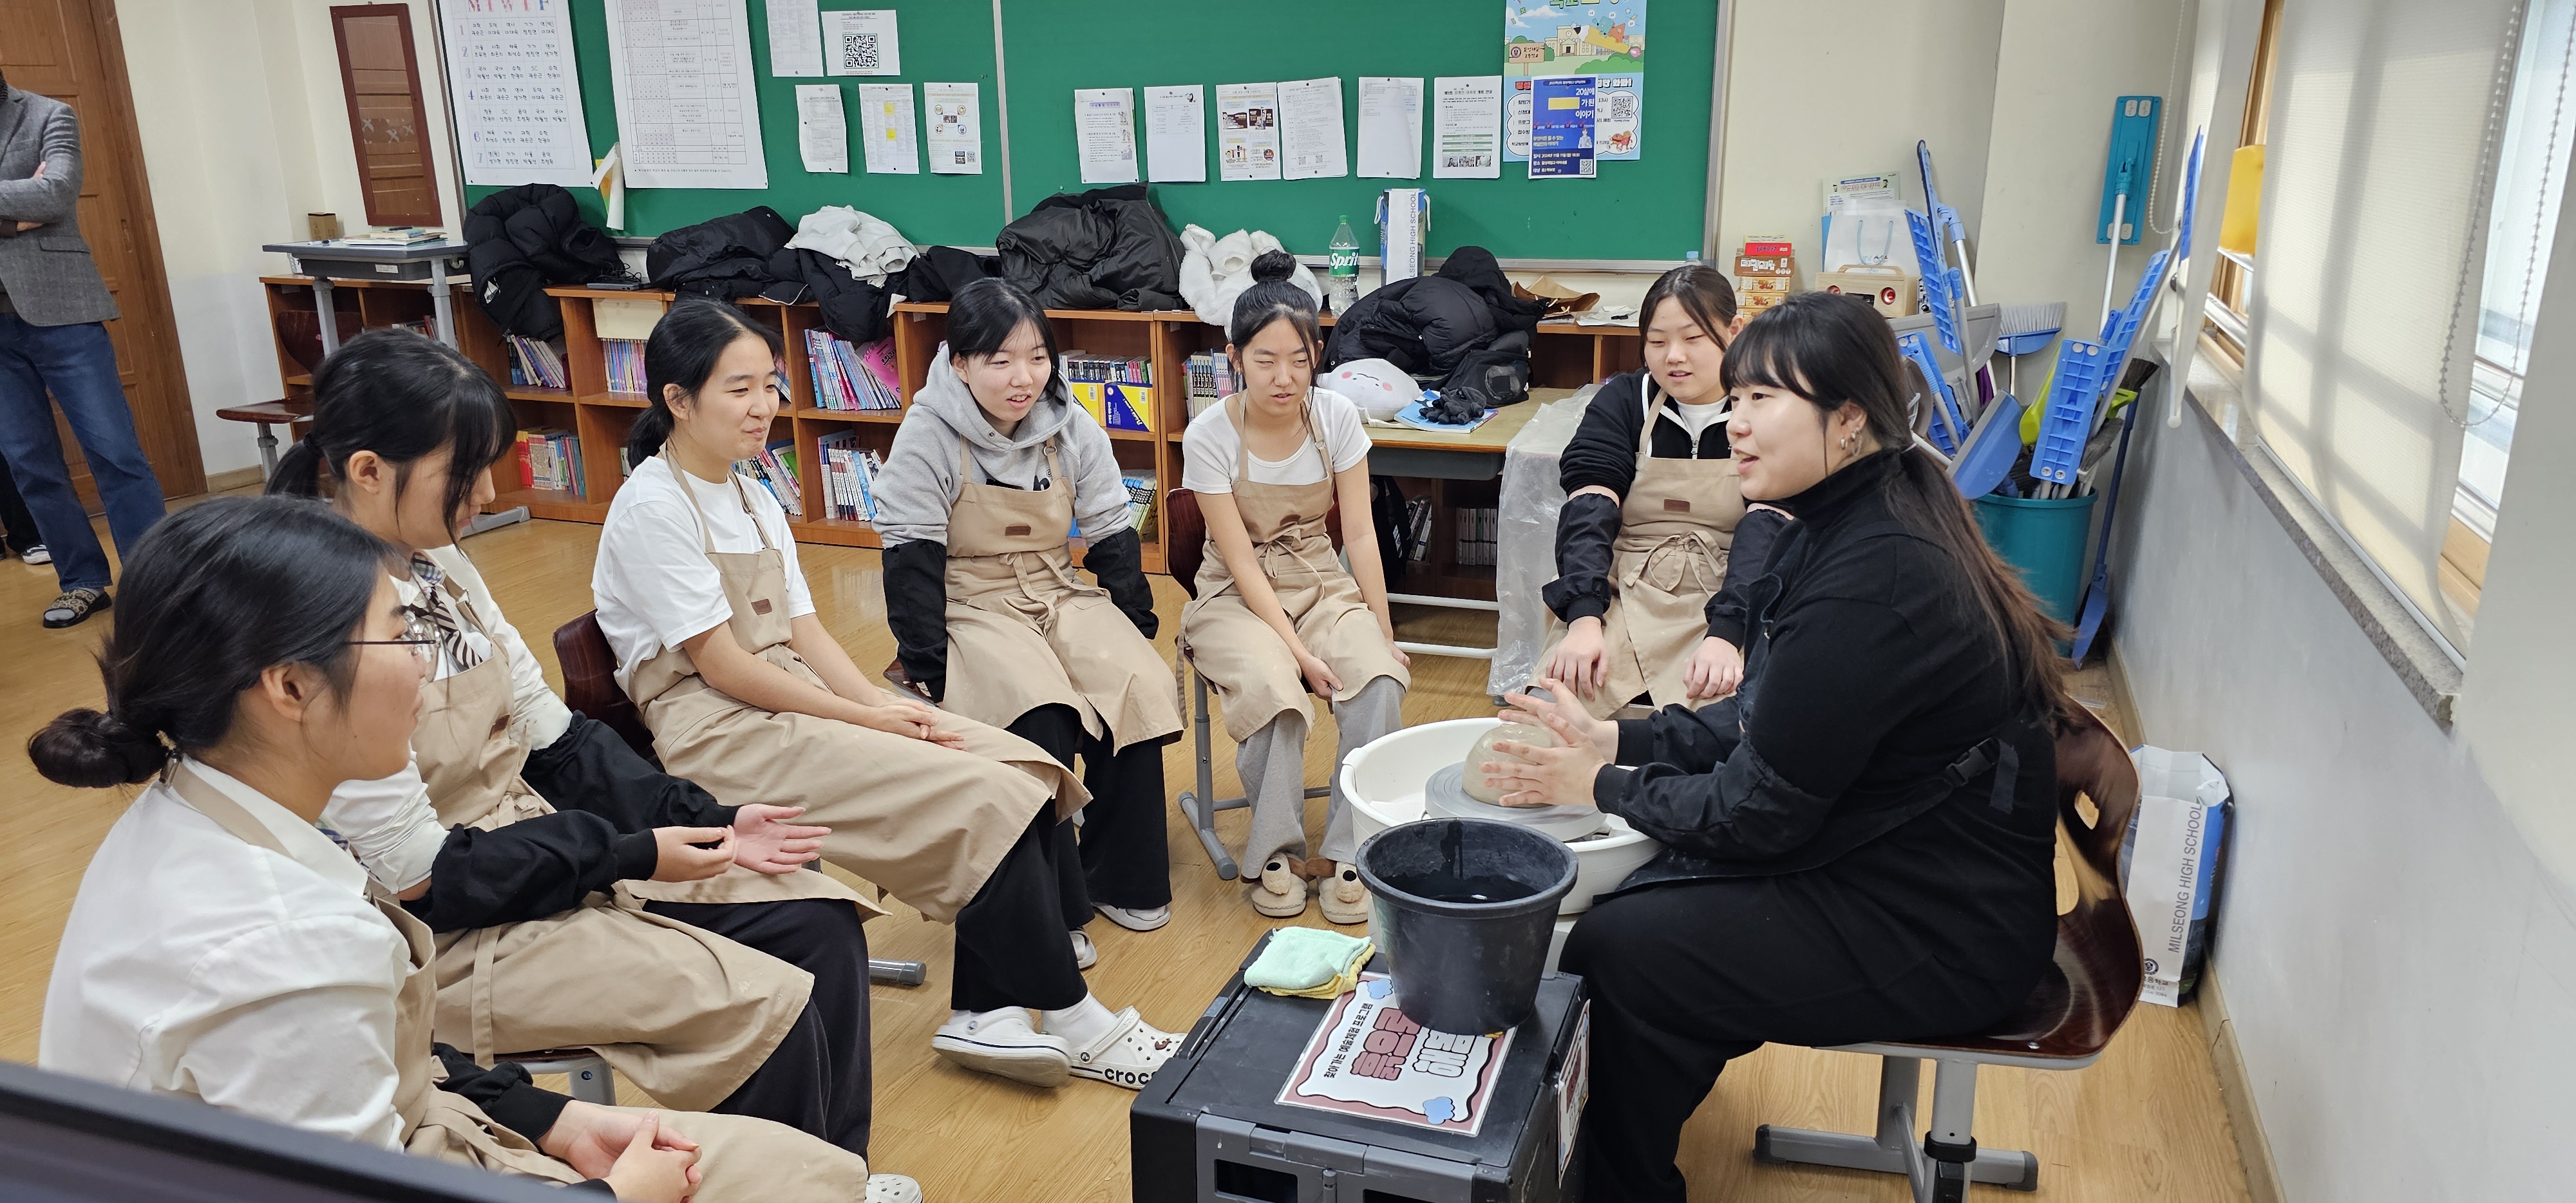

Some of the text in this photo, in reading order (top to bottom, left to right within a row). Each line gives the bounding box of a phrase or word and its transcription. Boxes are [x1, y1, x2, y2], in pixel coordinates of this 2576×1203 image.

[1575, 110, 1594, 118] 이야기
[474, 131, 480, 142] 6
[2168, 804, 2202, 953] MILSEONG HIGH SCHOOL
[1323, 1003, 1373, 1078] 찾아가는 예술체험 프로그램
